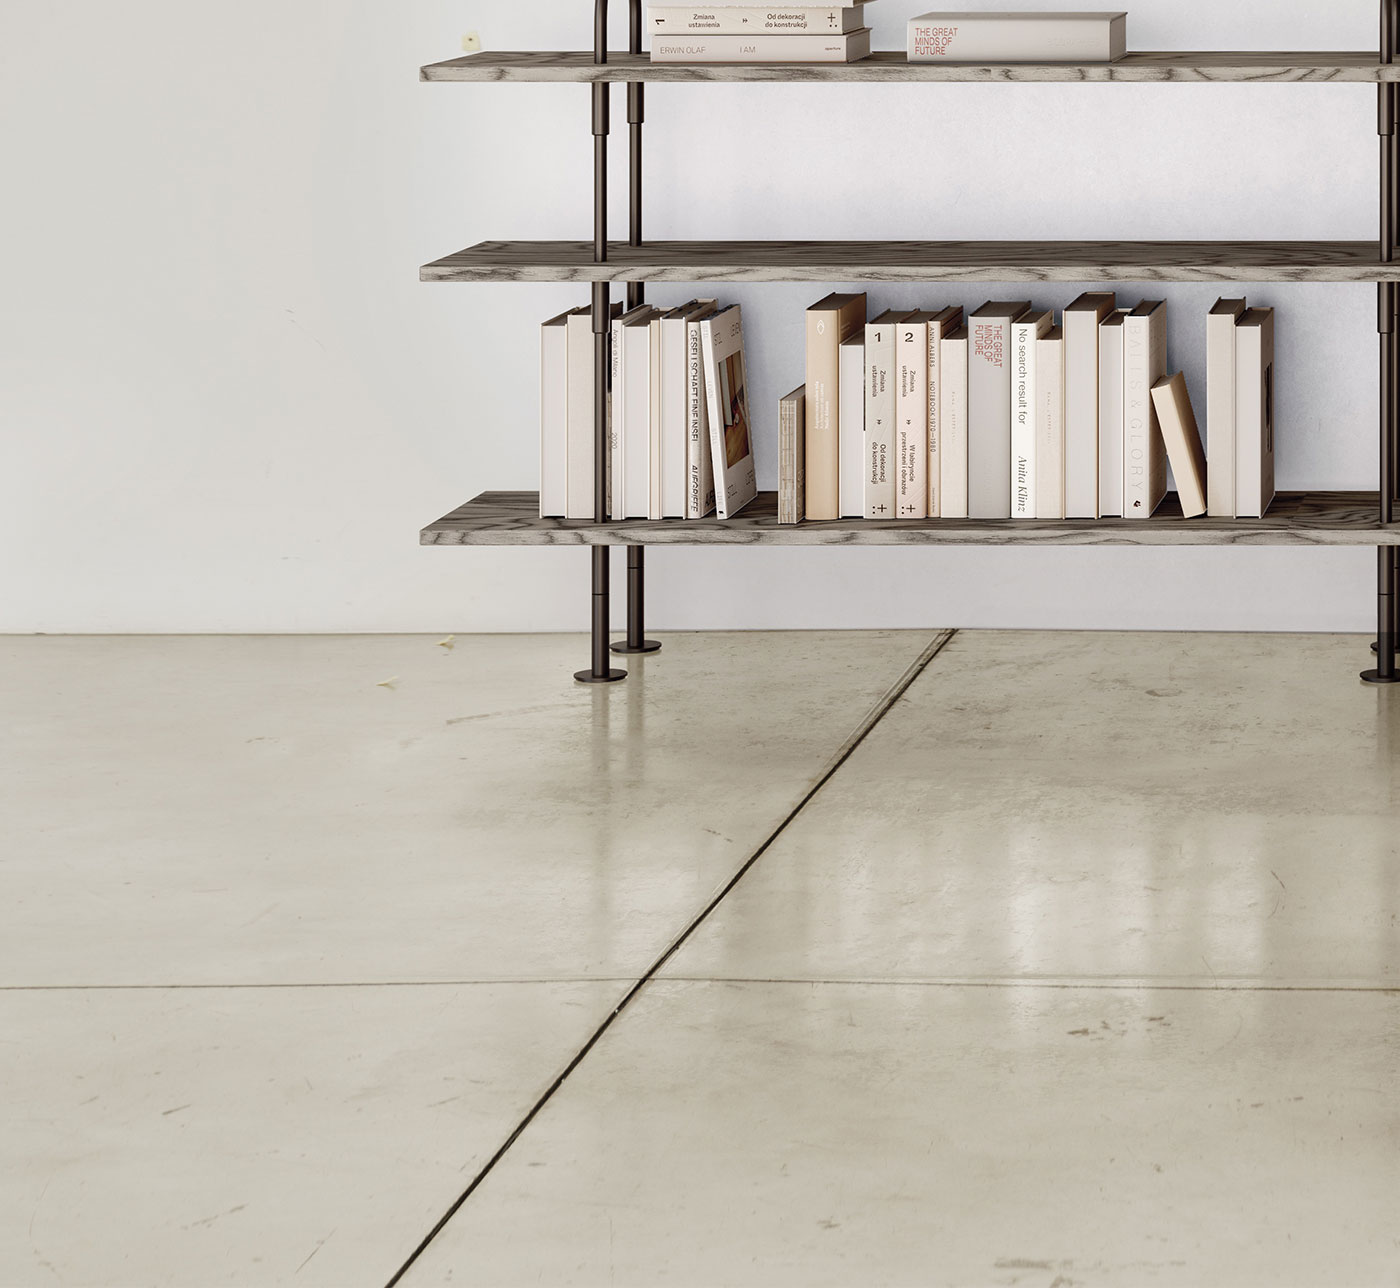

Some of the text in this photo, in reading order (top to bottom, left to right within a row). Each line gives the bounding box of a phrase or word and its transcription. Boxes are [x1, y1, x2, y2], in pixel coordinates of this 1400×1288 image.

[774, 21, 808, 29] konstrukcji
[777, 13, 806, 21] dekoracji
[915, 28, 958, 37] THE GREAT
[915, 37, 952, 46] MINDS OF
[915, 47, 945, 55] FUTURE
[611, 329, 619, 349] Angoli
[874, 332, 881, 342] 1
[904, 332, 914, 342] 2
[975, 324, 984, 355] FUTURE
[984, 324, 993, 362] MINDS OF
[994, 324, 1003, 368] THE GREAT
[1018, 328, 1027, 425] No search result for
[1131, 399, 1142, 408] &
[872, 442, 878, 450] do
[900, 431, 908, 465] przestrzeni
[1130, 418, 1144, 489] GLORY
[879, 444, 887, 482] Od dekoracji
[908, 452, 916, 482] labiryncie
[1018, 455, 1028, 512] Anita Klinz
